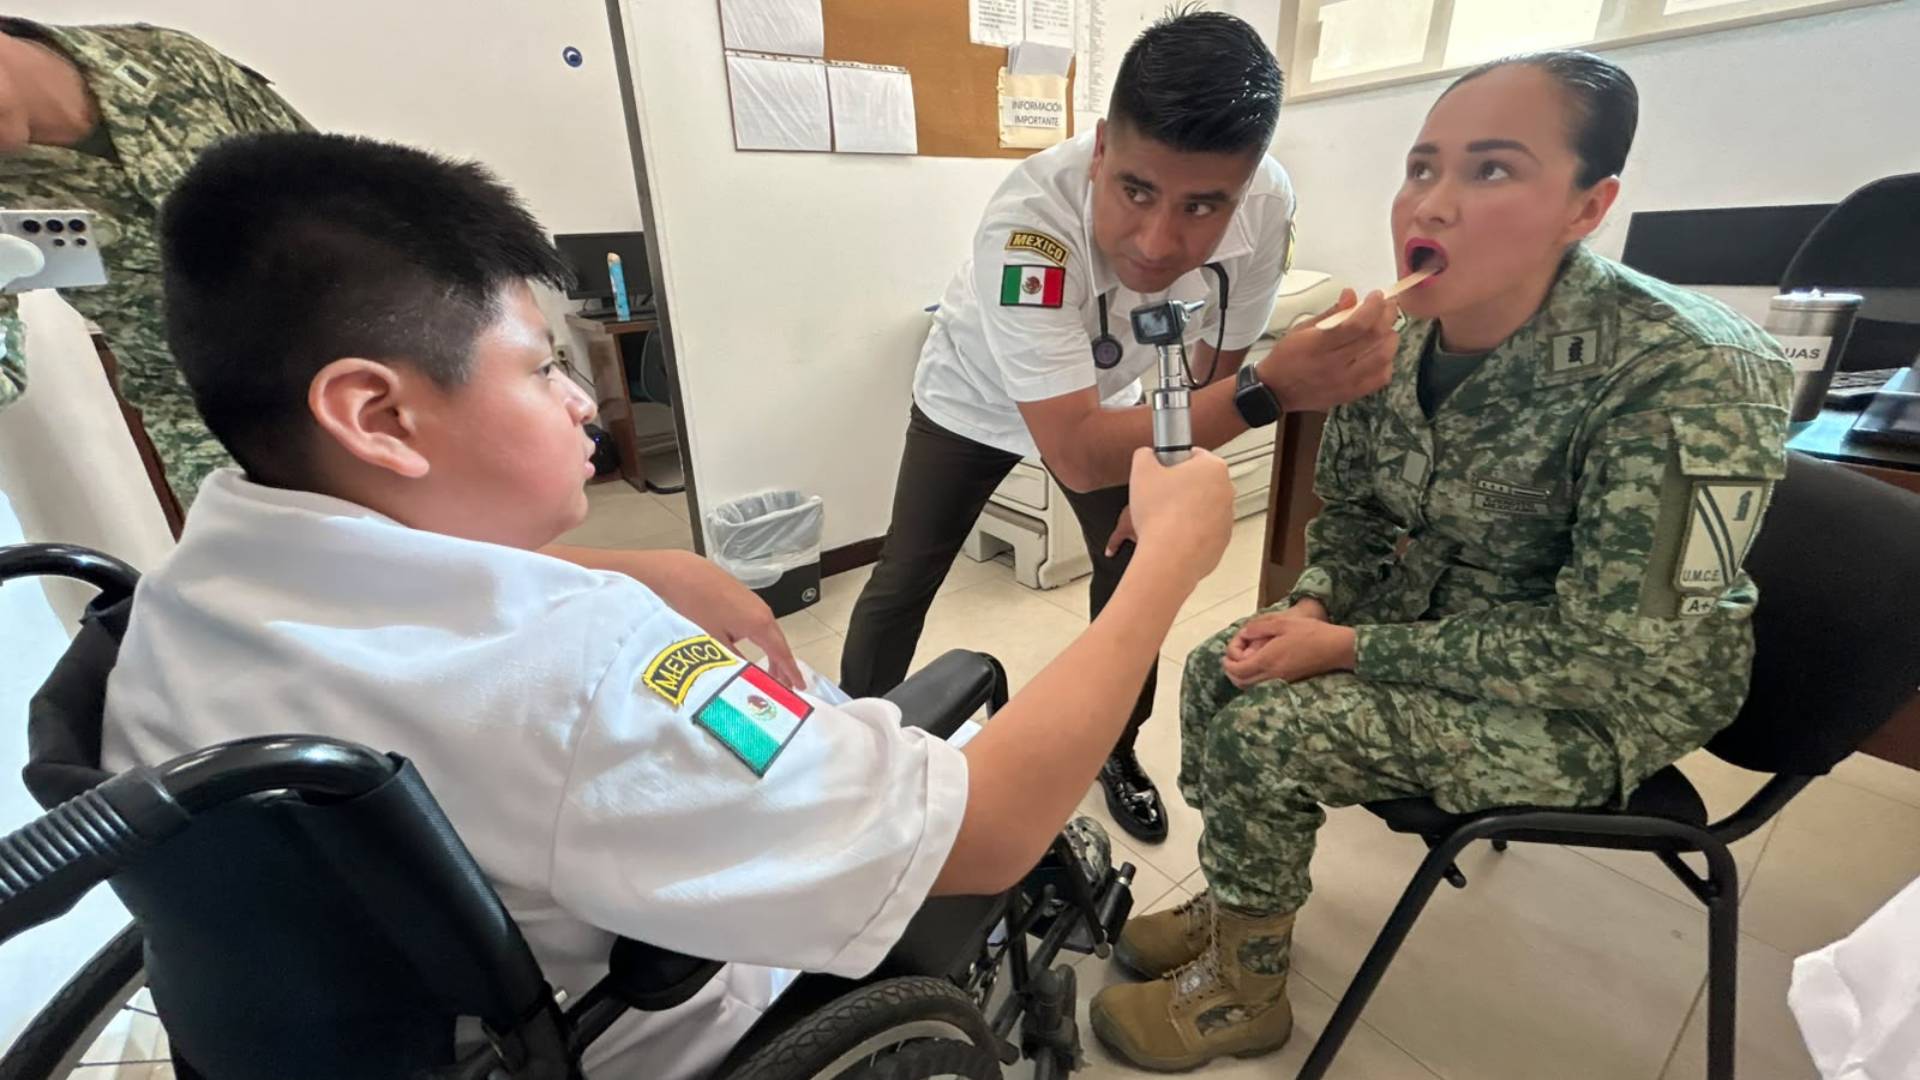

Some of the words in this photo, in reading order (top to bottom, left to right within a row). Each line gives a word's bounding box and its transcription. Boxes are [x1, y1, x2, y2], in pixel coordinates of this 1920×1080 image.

[1012, 100, 1062, 113] INFORMACIÓN
[1014, 115, 1059, 127] IMPORTANTE
[1012, 233, 1064, 261] MEXICO
[1687, 599, 1710, 612] A+
[655, 643, 721, 691] MEXICO
